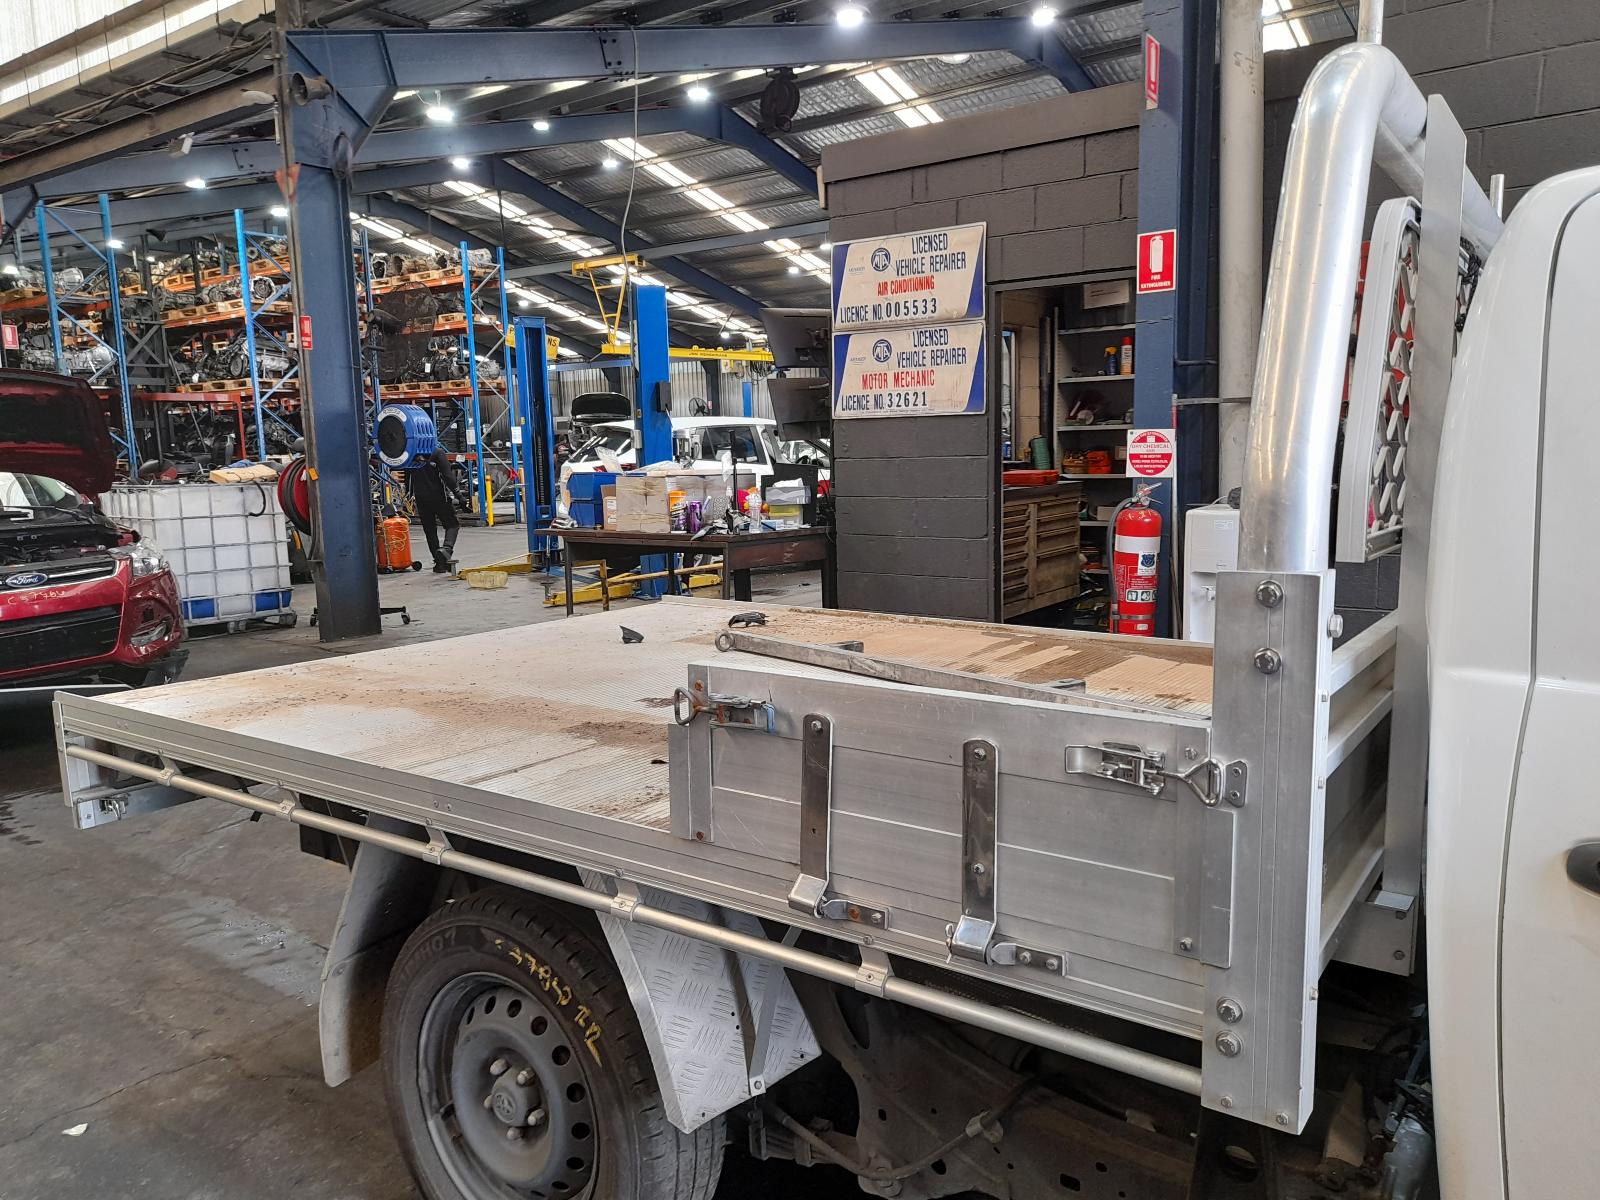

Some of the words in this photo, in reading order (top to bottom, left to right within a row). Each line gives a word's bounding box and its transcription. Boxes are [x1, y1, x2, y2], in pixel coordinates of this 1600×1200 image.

[912, 233, 948, 254] LICENSED
[895, 257, 926, 277] VEHICLE
[929, 251, 967, 273] REPAIRER
[877, 281, 889, 297] AIR
[890, 276, 935, 294] CONDITIONING
[840, 304, 869, 324] LICENCE
[872, 303, 884, 320] NO.
[885, 297, 938, 318] 005533
[912, 328, 949, 348] LICENSED
[896, 351, 927, 369] VEHICLE
[930, 346, 967, 366] REPAIRER
[861, 372, 888, 390] MOTOR
[893, 369, 935, 388] MECHANIC
[841, 394, 870, 411] LICENCE
[873, 393, 885, 410] NO.
[887, 391, 927, 408] 32621
